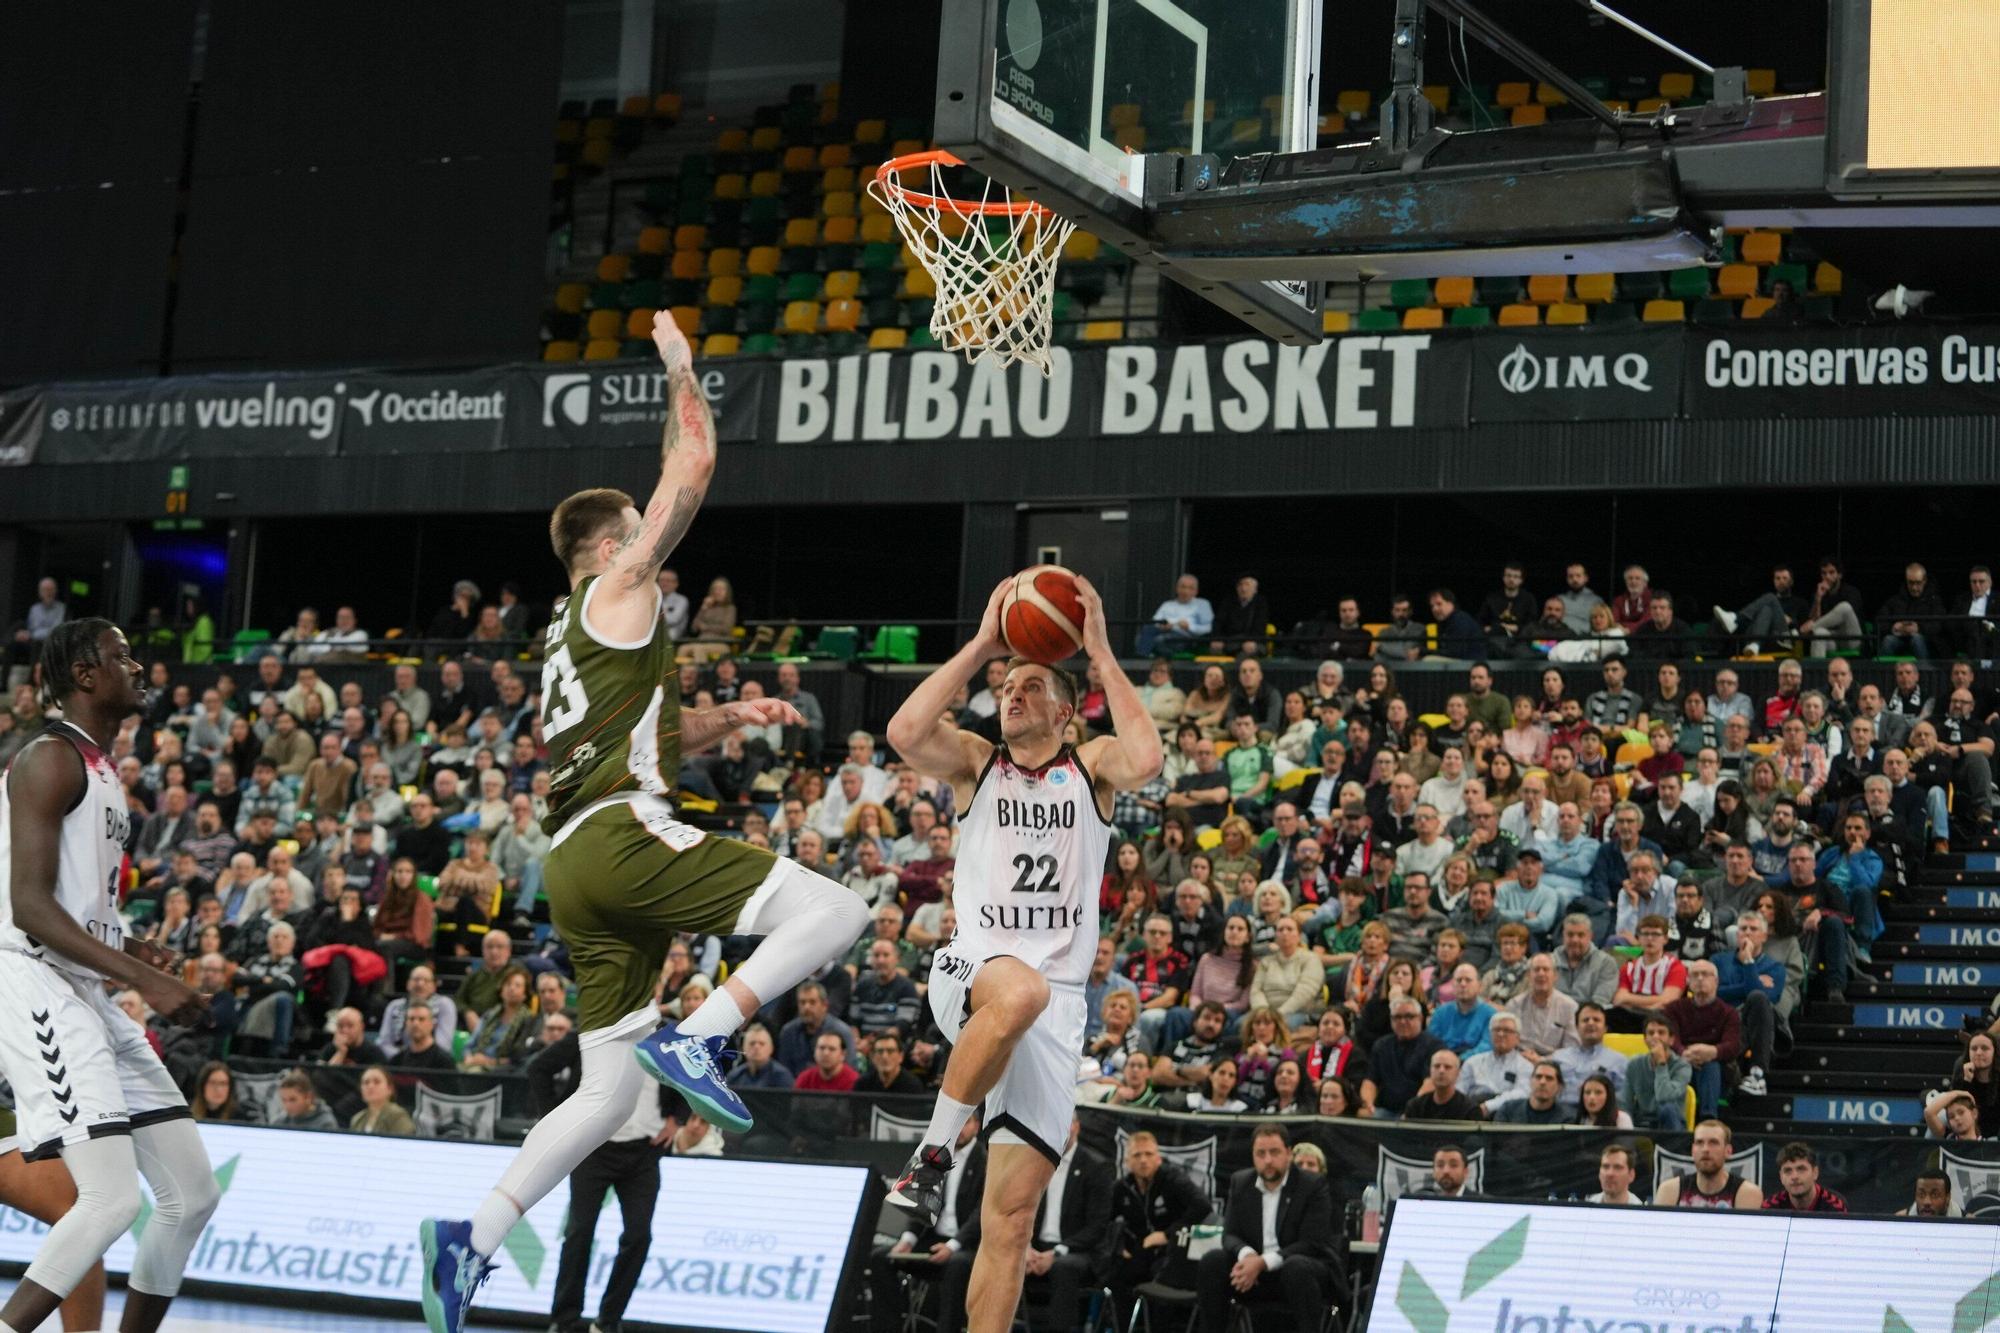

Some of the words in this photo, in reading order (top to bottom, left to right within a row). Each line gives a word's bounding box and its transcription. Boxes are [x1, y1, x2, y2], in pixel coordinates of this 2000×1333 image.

[1544, 352, 1653, 392] IMQ
[1705, 339, 1928, 388] Conservas
[1941, 334, 2000, 384] Cu
[600, 370, 725, 405] sure
[776, 346, 1073, 443] BILBAO
[1101, 334, 1432, 434] BASKET
[196, 381, 346, 440] vueling
[381, 389, 505, 423] Occident
[997, 798, 1075, 830] BILBAO
[1010, 853, 1061, 893] 22
[979, 903, 1083, 931] surne
[1925, 966, 1982, 986] IMQ
[1886, 1007, 1945, 1029] IMQ
[1828, 1101, 1891, 1124] IMQ
[193, 1224, 416, 1289] Intxausti
[703, 1229, 777, 1252] GRUPO
[1633, 1286, 1721, 1310] GRUPO
